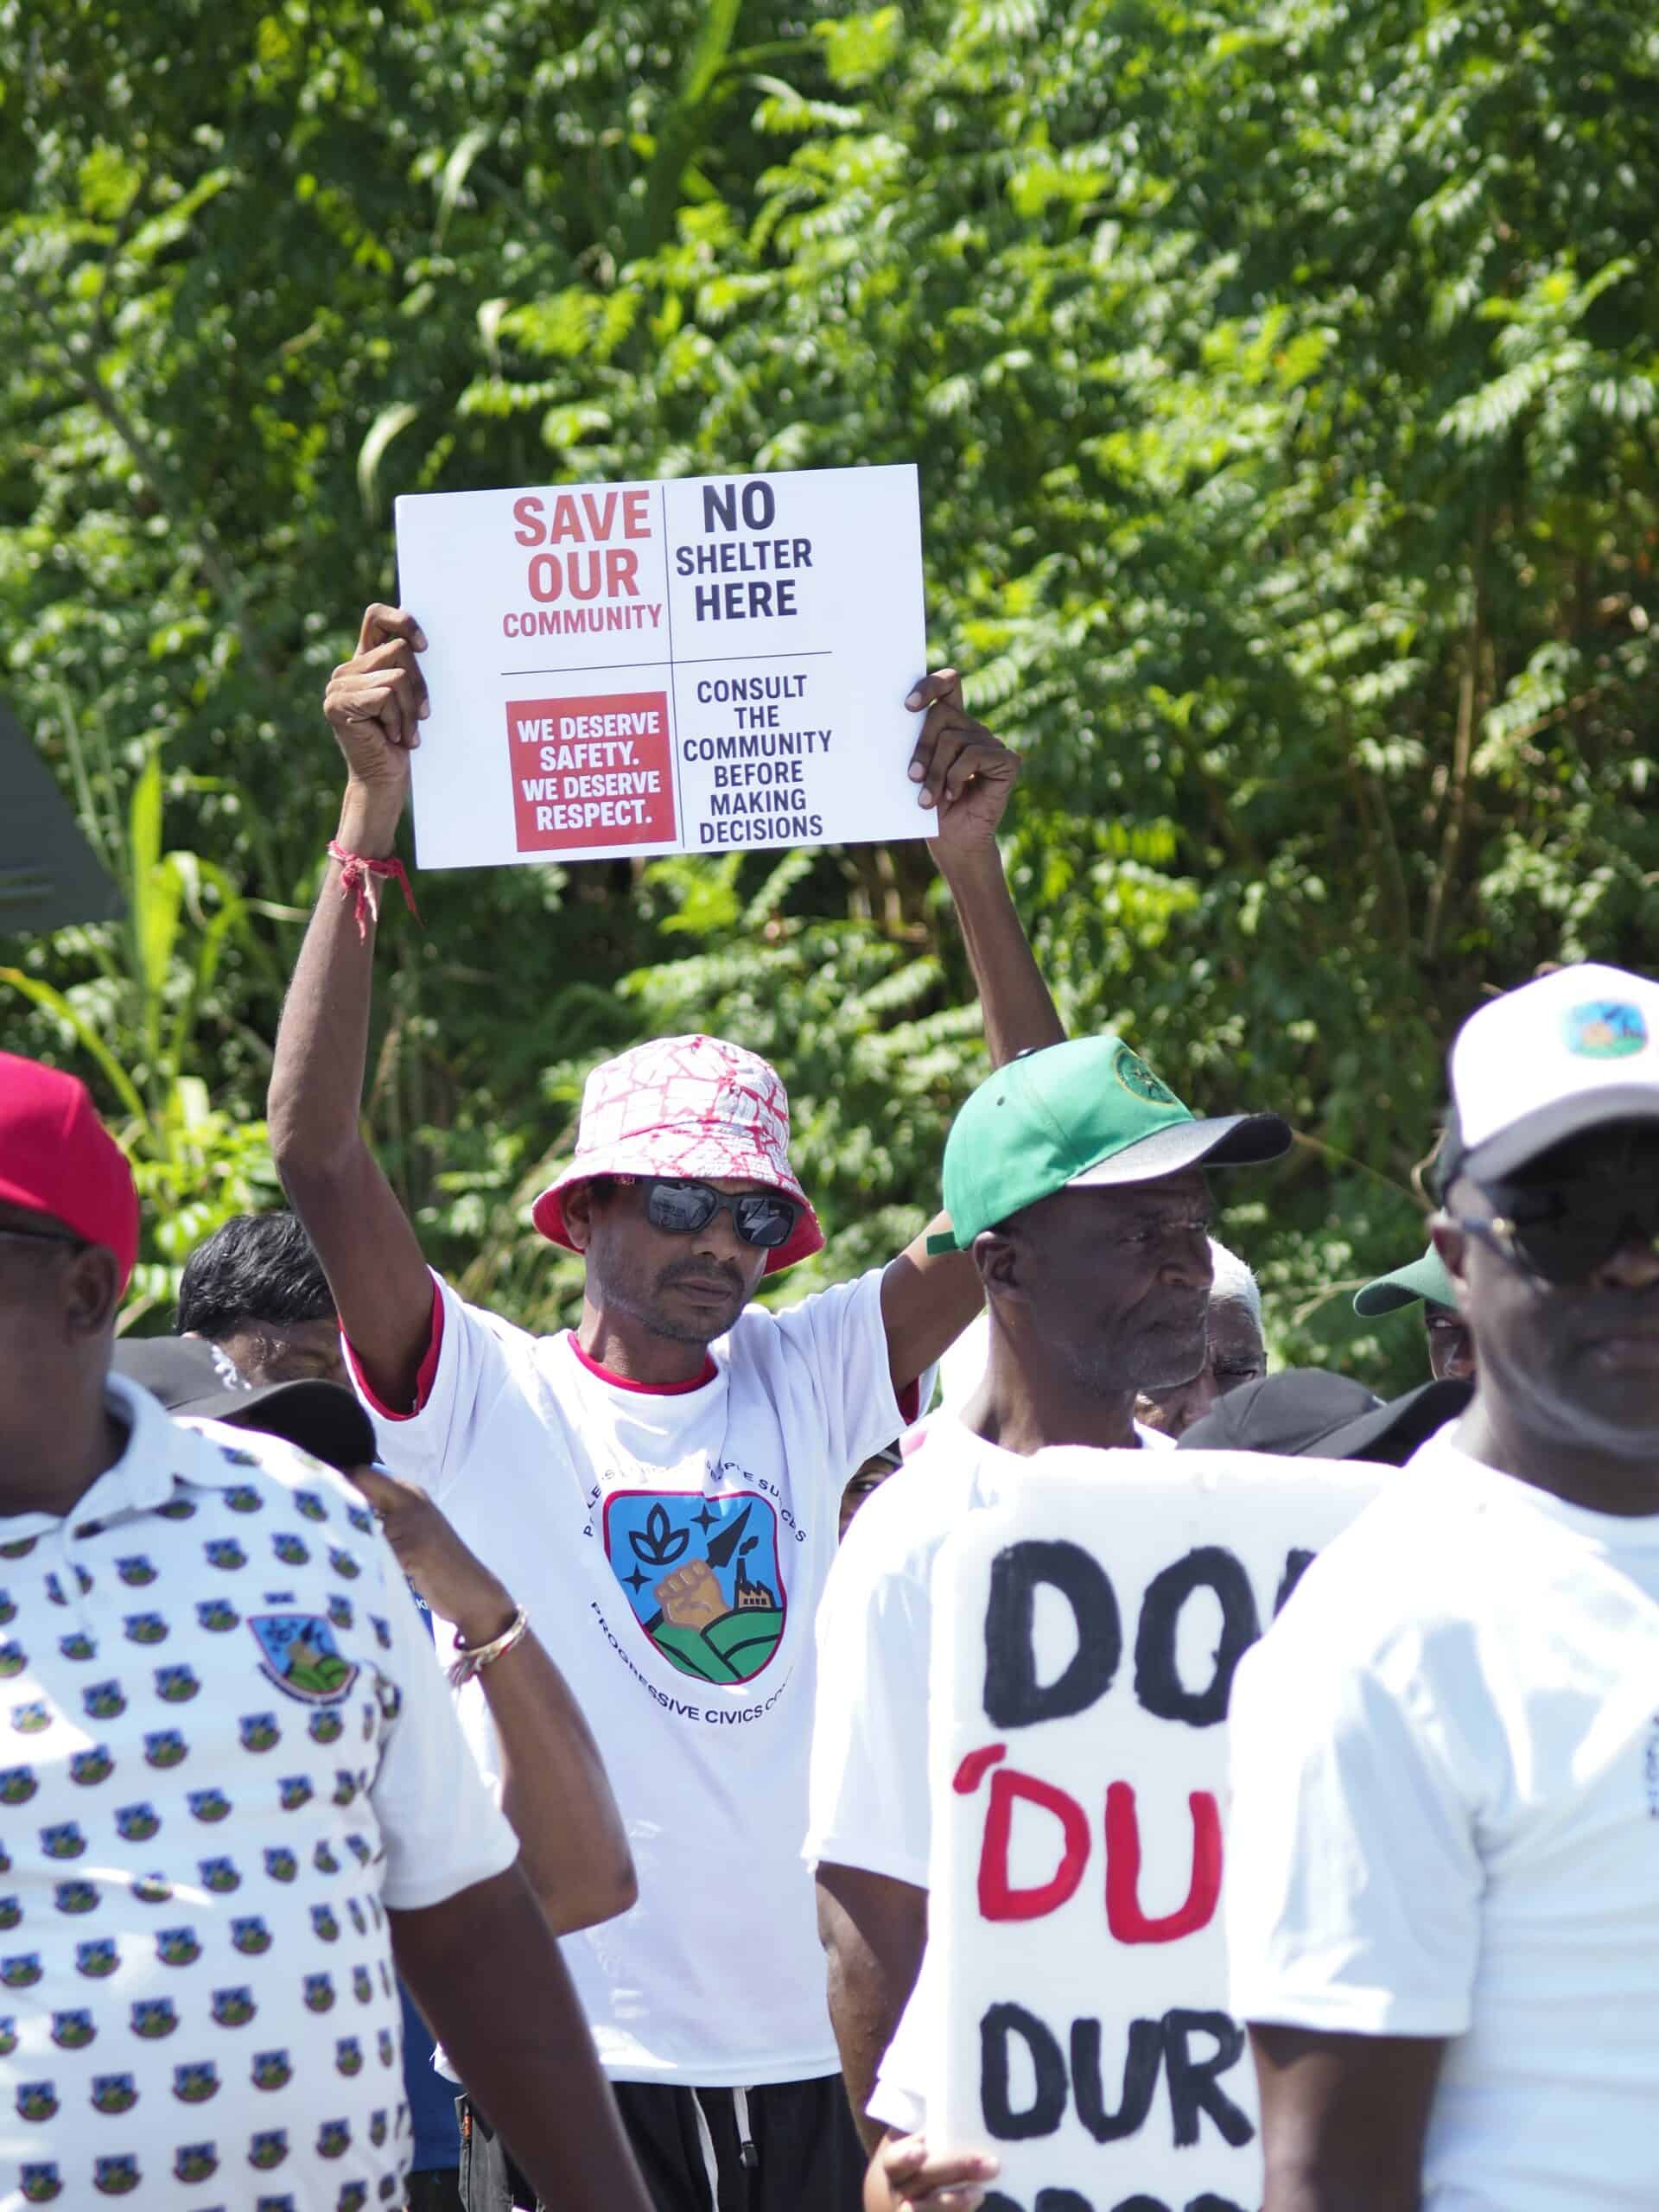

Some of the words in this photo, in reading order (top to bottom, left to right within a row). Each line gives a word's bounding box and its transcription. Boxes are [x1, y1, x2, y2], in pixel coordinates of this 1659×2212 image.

[513, 490, 652, 546] SAVE
[702, 480, 777, 534] NO
[675, 537, 814, 577] SHELTER
[528, 548, 639, 602] OUR
[694, 579, 799, 622] HERE
[503, 603, 664, 639] COMMUNITY
[696, 675, 808, 704] CONSULT
[516, 718, 555, 743] WE
[559, 711, 660, 741] DESERVE
[734, 704, 781, 730] THE
[539, 741, 640, 772] SAFETY.
[683, 729, 833, 762] COMMUNITY
[521, 776, 560, 802] WE
[563, 771, 662, 799] DESERVE
[714, 760, 804, 788] BEFORE
[536, 798, 653, 832] RESPECT.
[709, 788, 807, 817] MAKING
[699, 815, 824, 845] DECISIONS
[982, 1538, 1319, 1731] DO
[704, 1704, 764, 1725] CIVICS
[979, 2001, 1256, 2148] DUR
